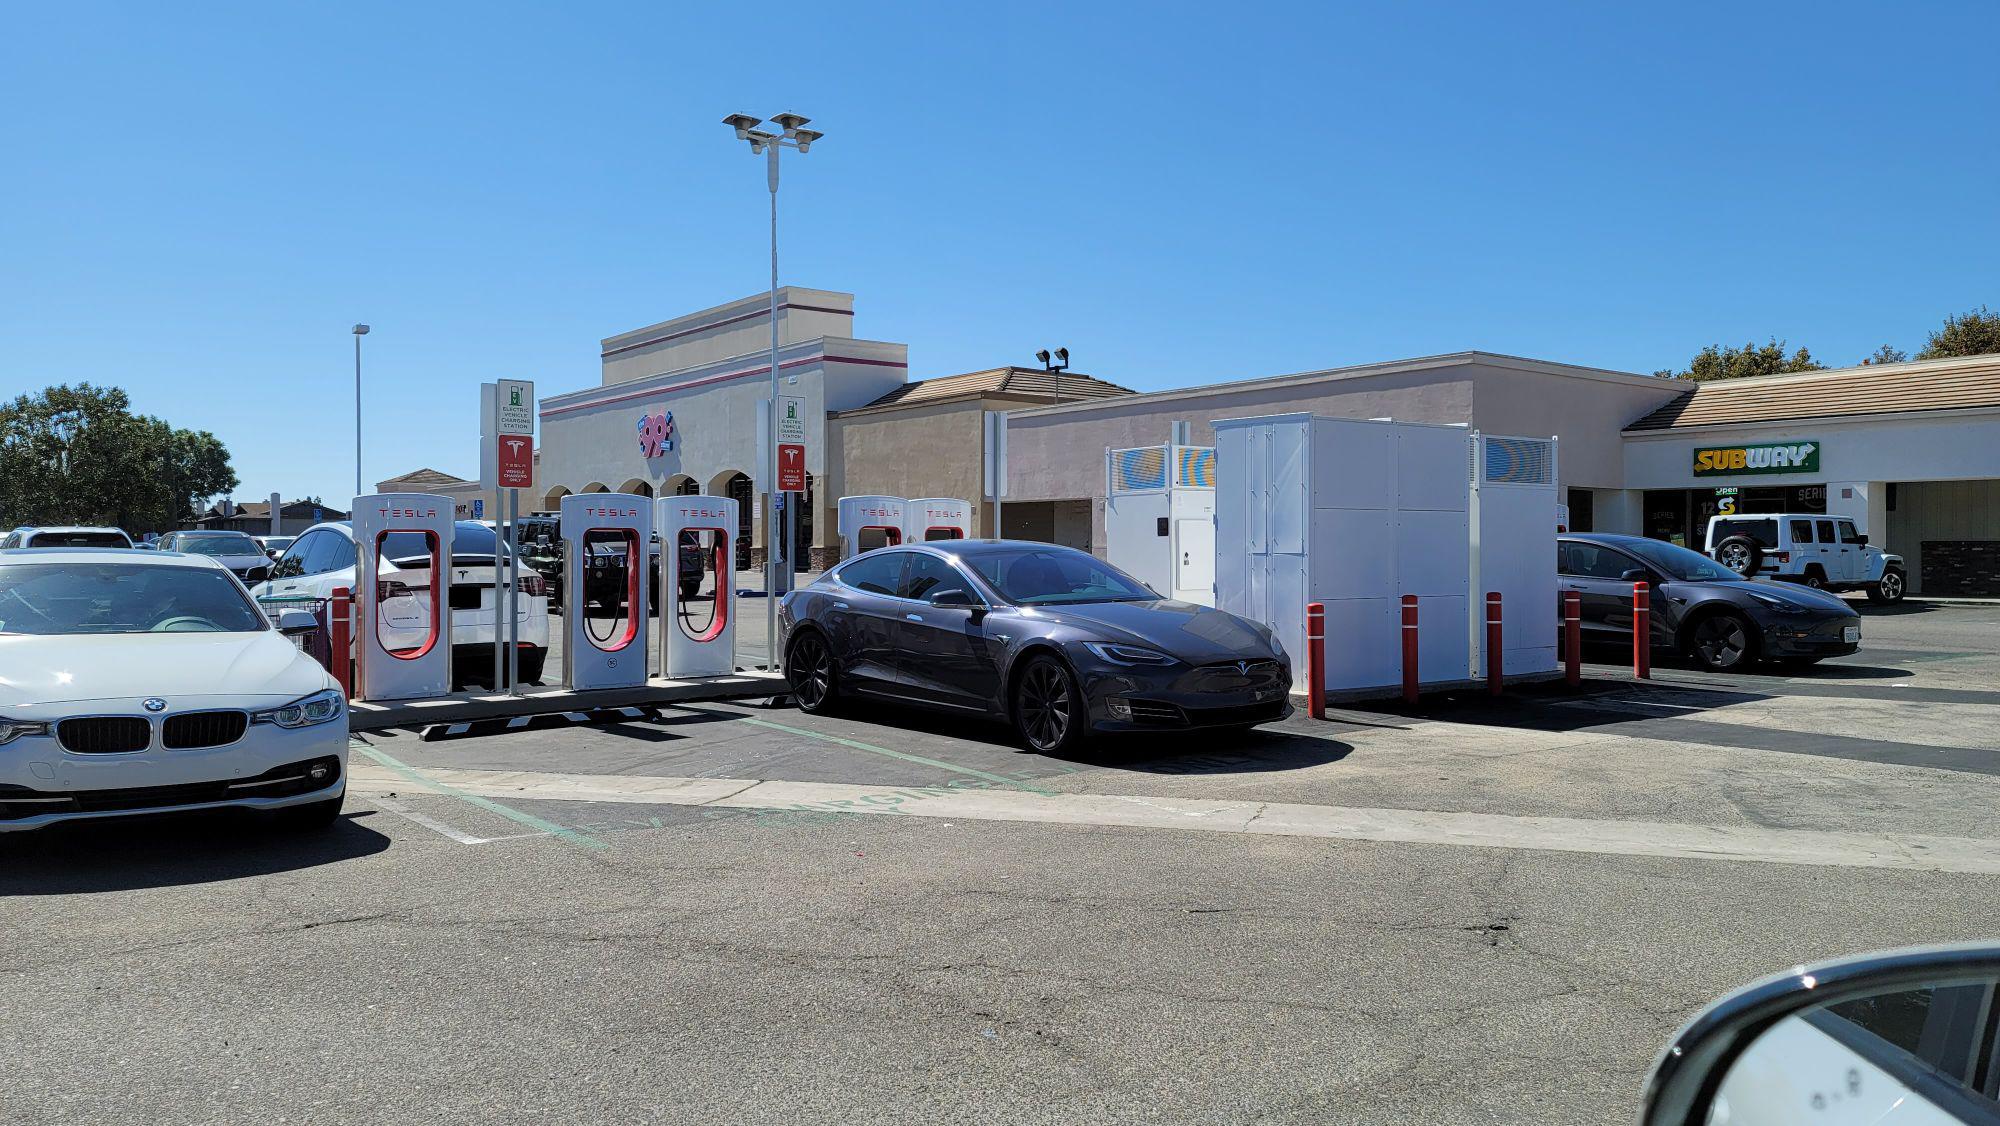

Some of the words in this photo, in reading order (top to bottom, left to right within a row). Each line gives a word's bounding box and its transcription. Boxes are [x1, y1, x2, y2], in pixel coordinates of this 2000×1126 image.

[1694, 443, 1816, 472] SUBWAY
[379, 509, 436, 517] TESLA
[586, 508, 637, 517] TESLA
[680, 509, 725, 517] TESLA
[927, 510, 962, 518] TESLA
